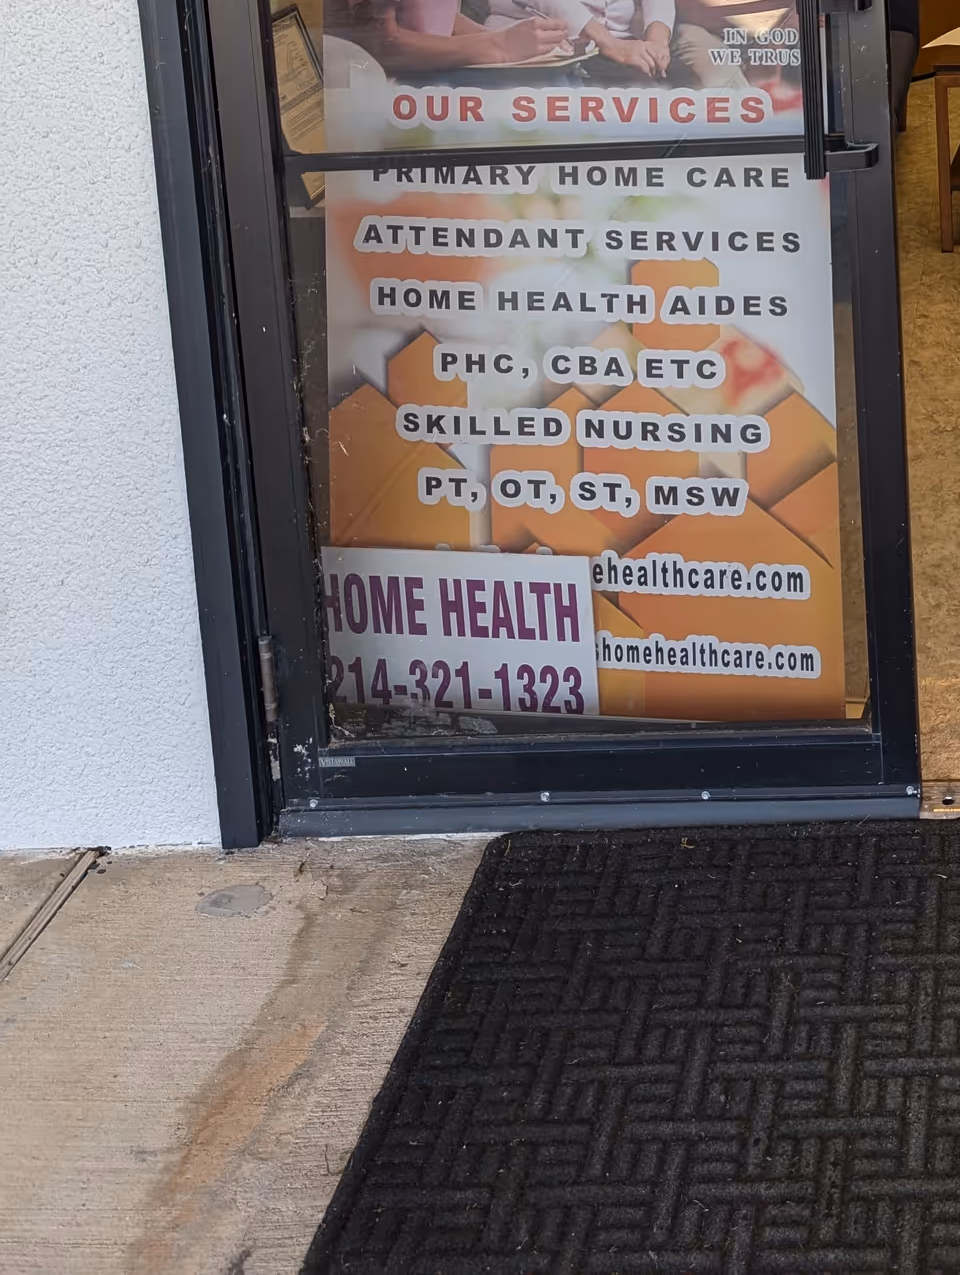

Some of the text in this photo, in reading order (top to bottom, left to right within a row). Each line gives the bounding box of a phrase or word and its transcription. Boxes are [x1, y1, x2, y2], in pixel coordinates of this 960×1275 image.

[724, 28, 799, 45] IN GOD
[708, 48, 742, 65] WE
[393, 94, 766, 124] OUR SERVICES
[372, 165, 790, 188] PRIMARY HOME CARE
[362, 224, 801, 253] ATTENDANT SERVICES
[377, 286, 788, 317] HOME HEALTH AIDES
[440, 352, 717, 379] PHC, CBA ETC
[403, 412, 762, 444] SKILLED NURSING
[425, 475, 740, 508] PT, OT, ST, MSW
[324, 573, 580, 643] HOME HEALTH
[330, 654, 585, 715] 214-321-1323
